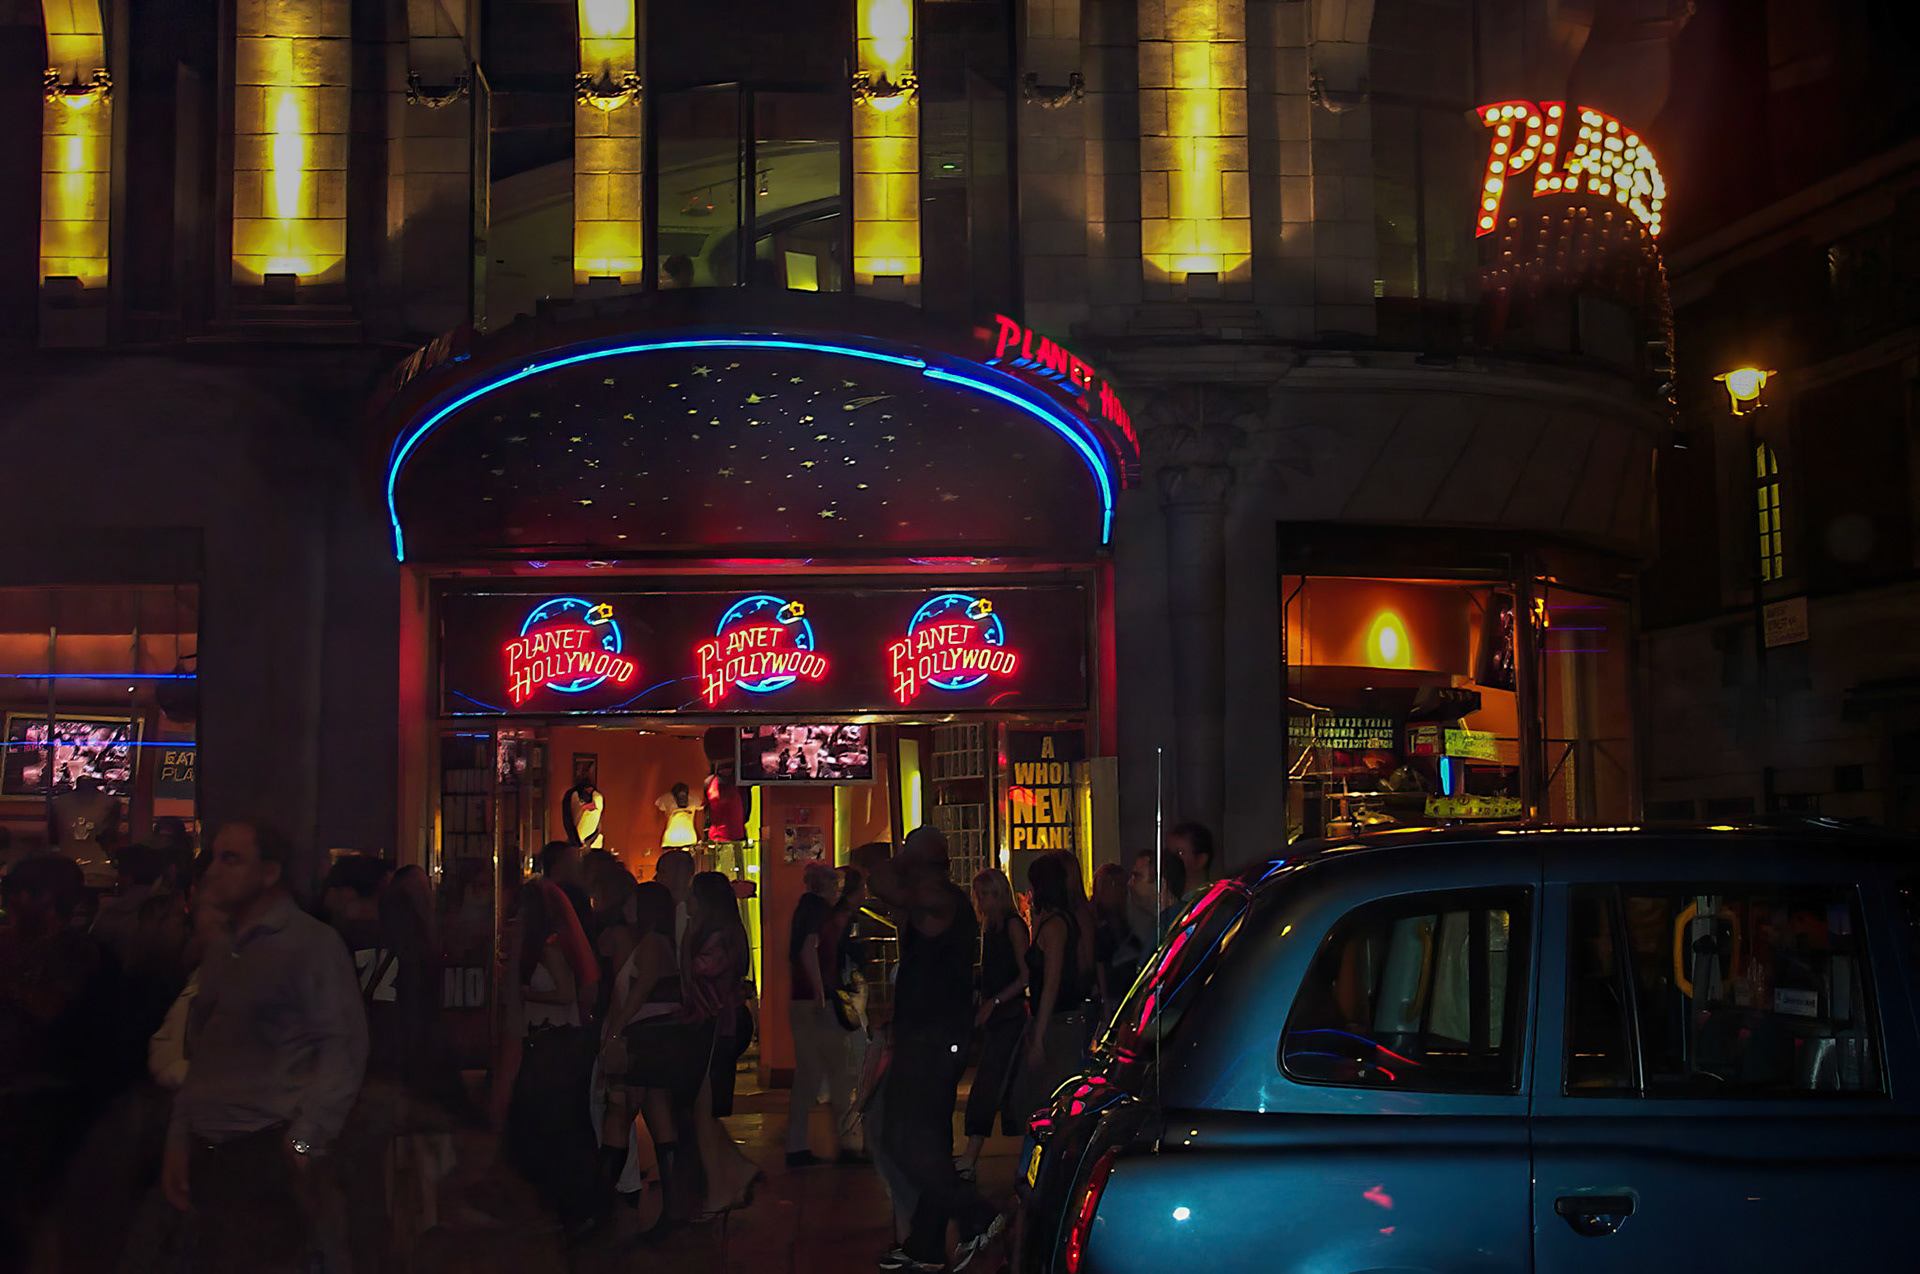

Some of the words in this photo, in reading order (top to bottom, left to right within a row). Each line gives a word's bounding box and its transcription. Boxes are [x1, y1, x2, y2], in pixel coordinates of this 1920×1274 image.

[995, 313, 1095, 390] PLANET
[505, 629, 591, 677] PLANET
[697, 627, 784, 679] PLANET
[888, 624, 976, 677] PLANET
[894, 648, 1016, 703] HOLLYWOOD
[508, 651, 634, 703] HOLLYWOOD
[702, 652, 826, 704] HOLLYWOOD
[1014, 761, 1074, 785] WHOL
[1041, 736, 1055, 759] A
[1012, 786, 1073, 824] NEW
[1013, 826, 1073, 850] PLANE
